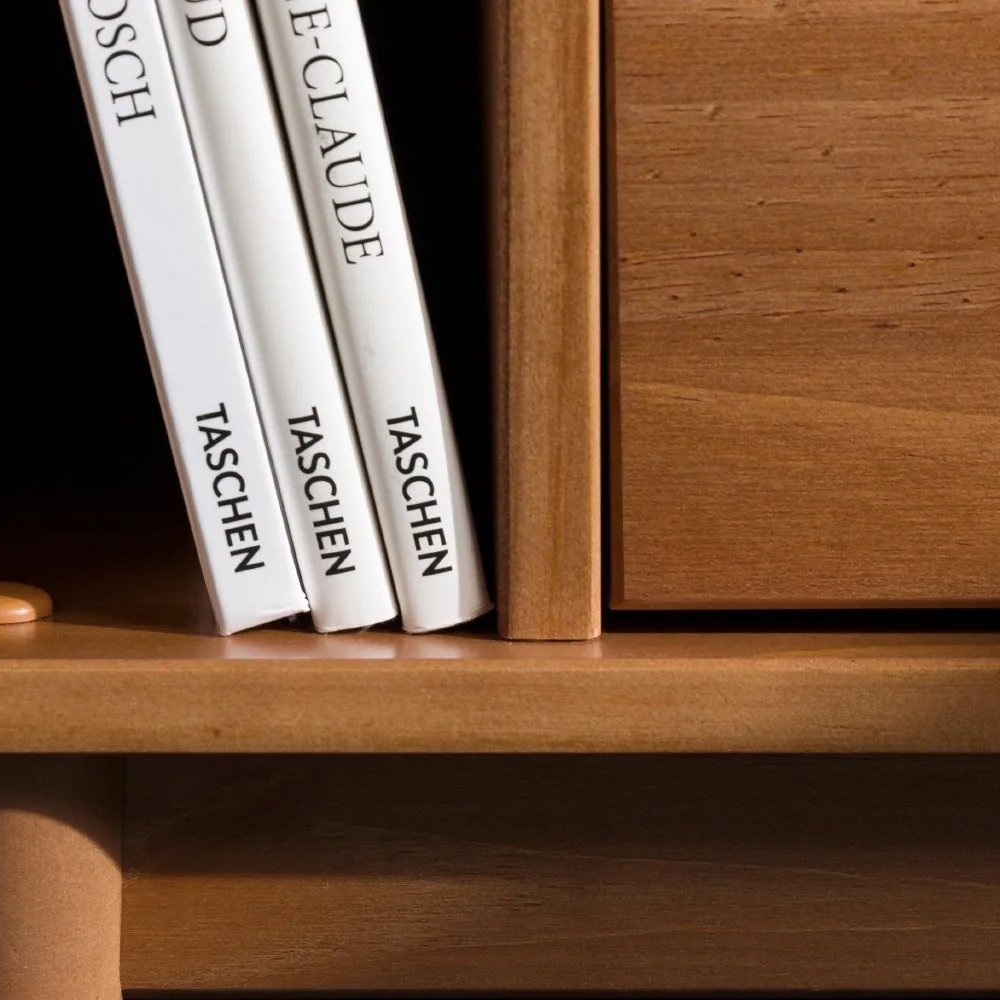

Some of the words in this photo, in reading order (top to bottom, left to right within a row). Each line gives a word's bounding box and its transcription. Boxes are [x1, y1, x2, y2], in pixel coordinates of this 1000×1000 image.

[285, 0, 384, 265] E-CLAUDE
[195, 402, 265, 573] TASCHEN
[287, 406, 356, 577] TASCHEN
[386, 406, 453, 577] TASCHEN
